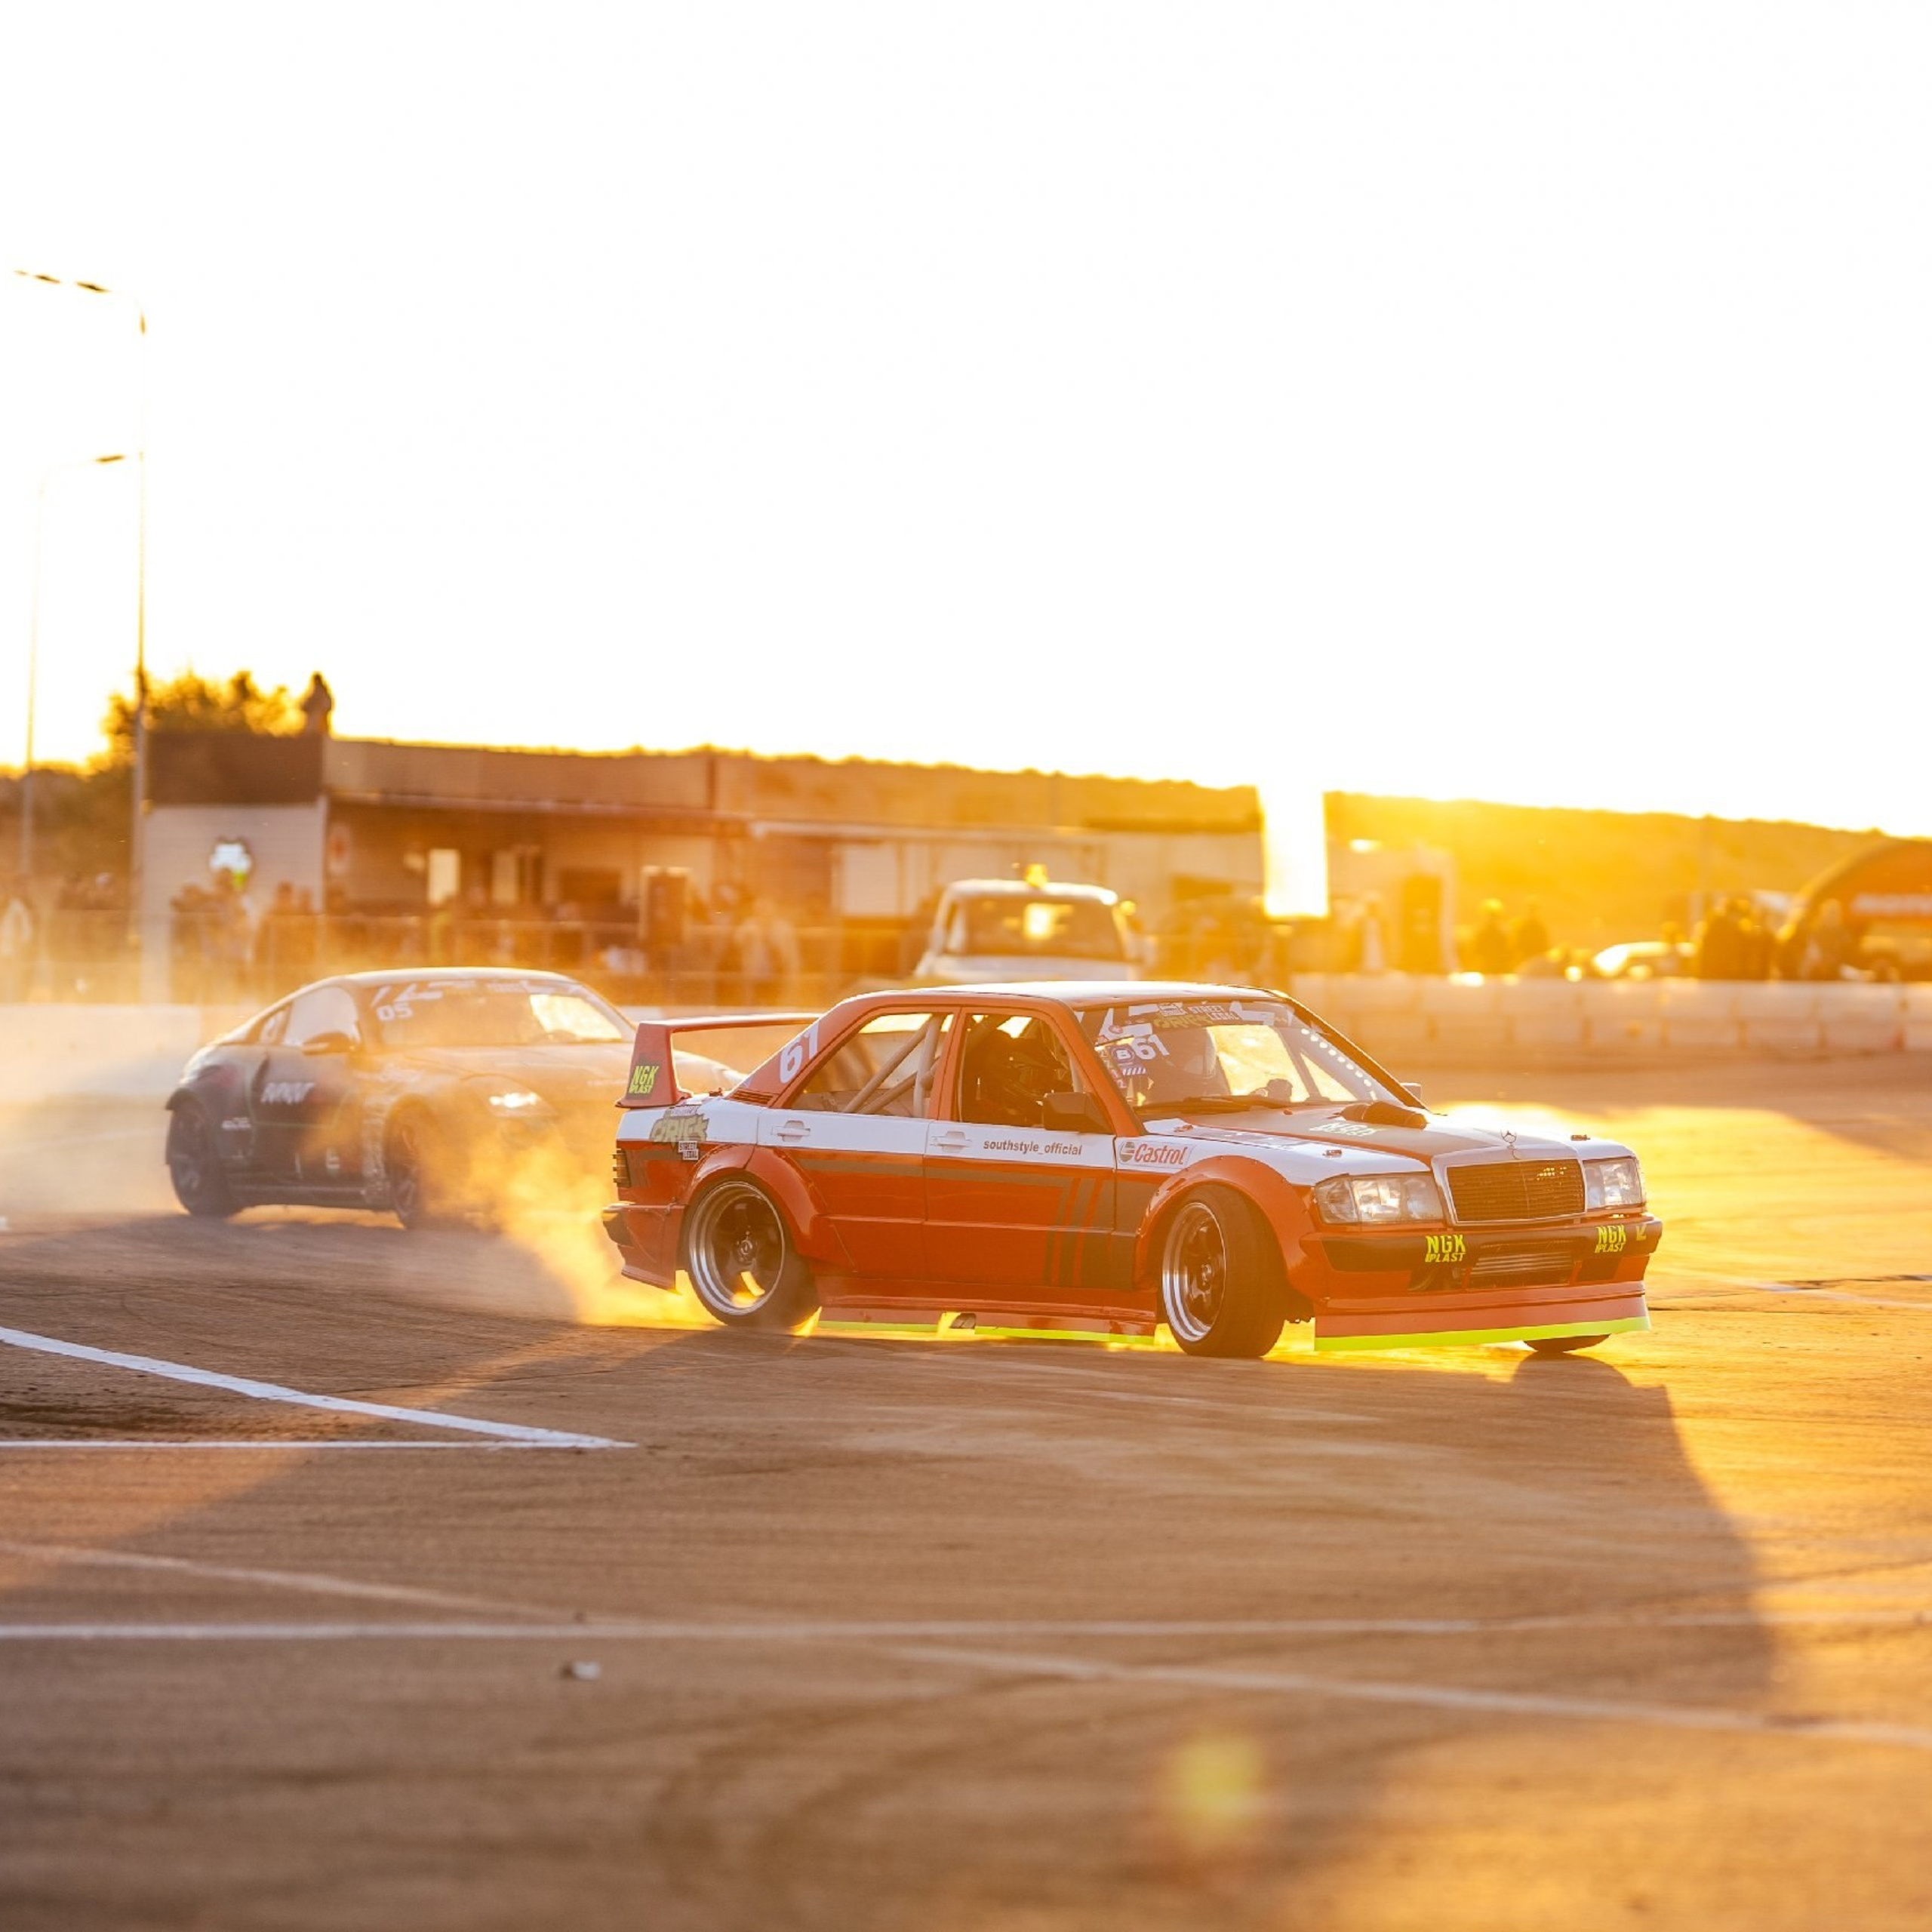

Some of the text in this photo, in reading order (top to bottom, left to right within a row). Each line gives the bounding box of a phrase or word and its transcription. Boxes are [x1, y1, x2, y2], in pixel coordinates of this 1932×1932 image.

[1187, 1004, 1226, 1014] STREET
[1207, 1011, 1241, 1020] LEGAL
[779, 1021, 819, 1084] 61
[1131, 1034, 1170, 1060] 61
[632, 1066, 660, 1085] NGK
[983, 1140, 1083, 1155] southstyle_official
[1134, 1143, 1188, 1164] Castrol
[1595, 1224, 1626, 1244] NGK
[1426, 1235, 1466, 1254] NGK
